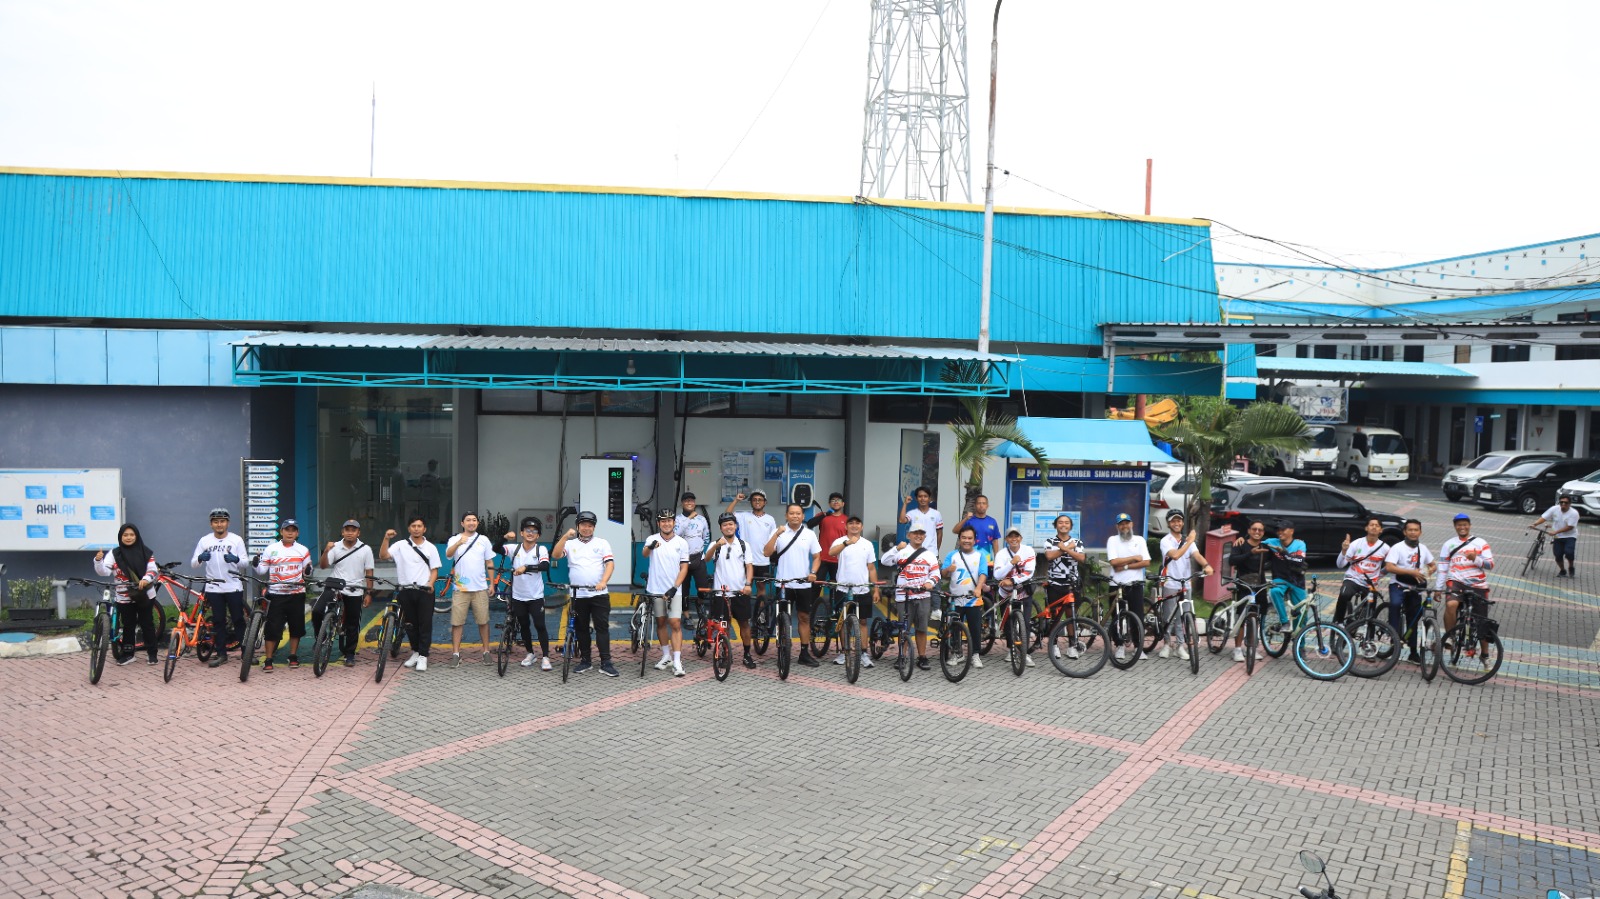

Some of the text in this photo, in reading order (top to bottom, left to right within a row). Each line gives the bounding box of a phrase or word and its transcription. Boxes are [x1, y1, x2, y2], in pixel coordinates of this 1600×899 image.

[1049, 469, 1066, 477] AREA
[1067, 469, 1091, 478] JEMBER
[1094, 470, 1110, 478] SING
[1110, 470, 1133, 478] PALING
[1133, 470, 1146, 479] SAE
[36, 504, 76, 515] AKHLAK
